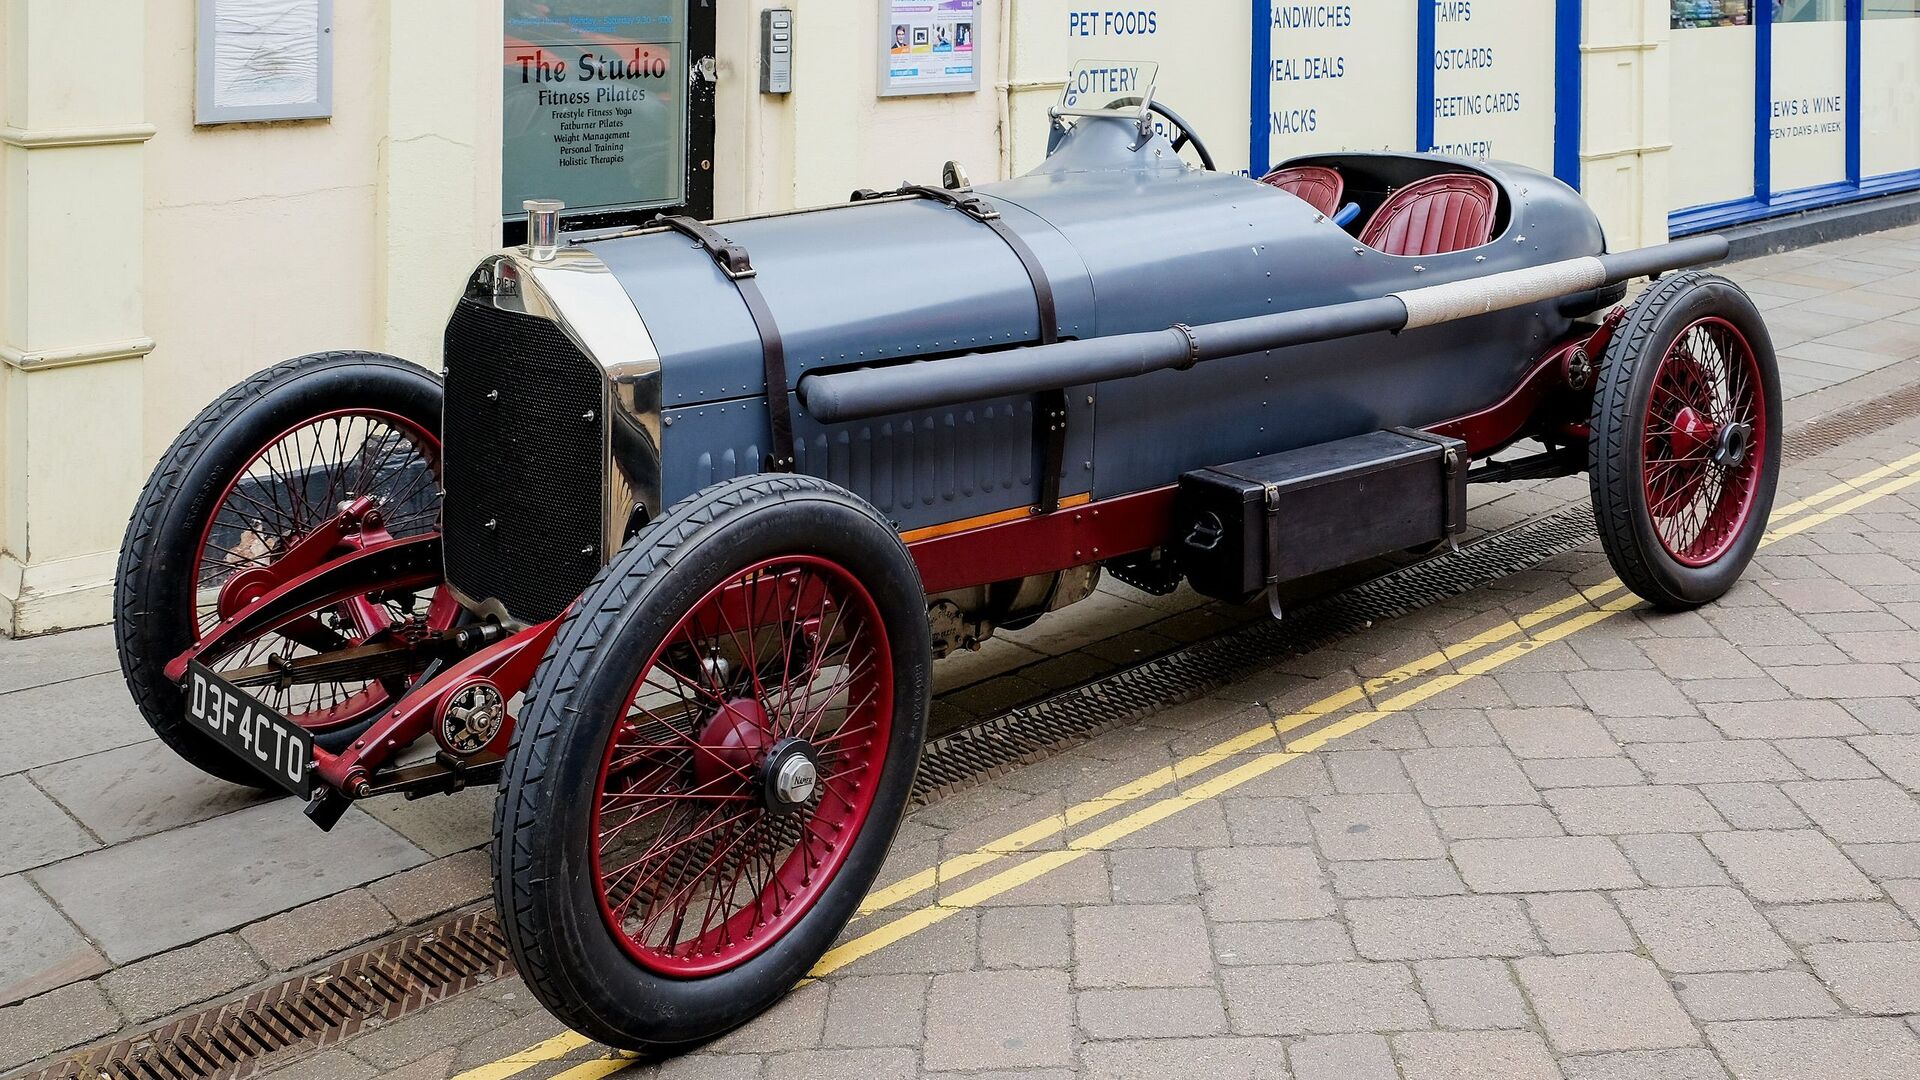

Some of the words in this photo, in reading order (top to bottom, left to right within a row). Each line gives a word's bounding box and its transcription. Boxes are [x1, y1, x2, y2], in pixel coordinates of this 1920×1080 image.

[1271, 6, 1351, 28] ANDWICHES
[1435, 1, 1471, 22] TAMPS
[1069, 12, 1099, 36] PET
[1104, 11, 1157, 35] FOODS
[516, 50, 566, 84] The
[578, 47, 666, 82] Studio
[1304, 57, 1344, 80] DEALS
[1435, 48, 1493, 70] OSTCARDS
[538, 89, 590, 106] Fitness
[596, 85, 646, 104] Pilates
[1435, 95, 1482, 117] REETING
[1485, 92, 1520, 113] CARDS
[1801, 98, 1809, 115] &
[1812, 96, 1841, 113] WINE
[551, 106, 585, 120] Freestyle
[587, 107, 613, 118] Fitness
[615, 107, 633, 118] Yoga
[1271, 109, 1317, 135] NACKS
[560, 121, 596, 131] Fatburner
[599, 119, 624, 129] Pilates
[1769, 128, 1785, 140] PEN
[1787, 127, 1791, 138] 7
[1792, 125, 1812, 137] DAYS
[1813, 124, 1819, 135] A
[1820, 121, 1841, 134] WEEK
[554, 133, 580, 144] Weight
[582, 131, 630, 142] Management
[560, 145, 592, 155] Personal
[595, 143, 624, 154] Training
[559, 156, 588, 167] Holistic
[590, 155, 625, 166] Therapies
[191, 672, 304, 784] D3F4CTO
